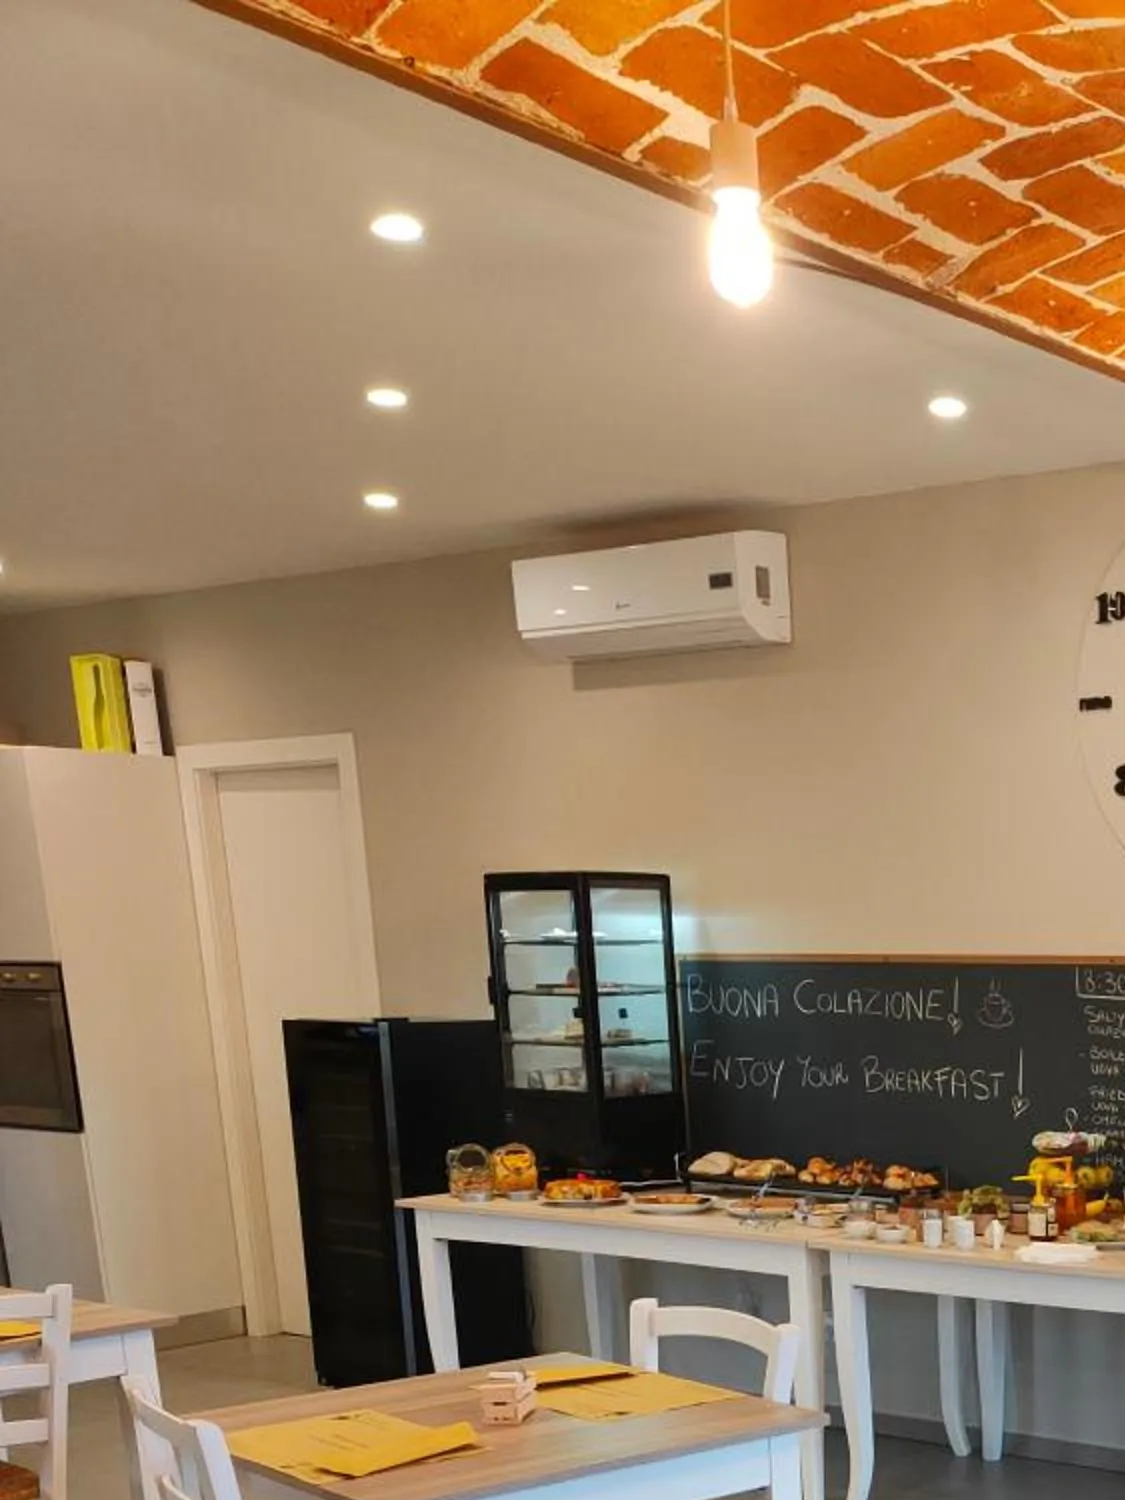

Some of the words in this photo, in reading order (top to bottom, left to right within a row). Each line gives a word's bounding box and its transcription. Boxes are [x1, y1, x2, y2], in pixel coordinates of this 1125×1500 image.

[686, 973, 780, 1018] BUONA
[690, 1039, 785, 1100] ENJOY
[797, 1055, 849, 1089] YOUR
